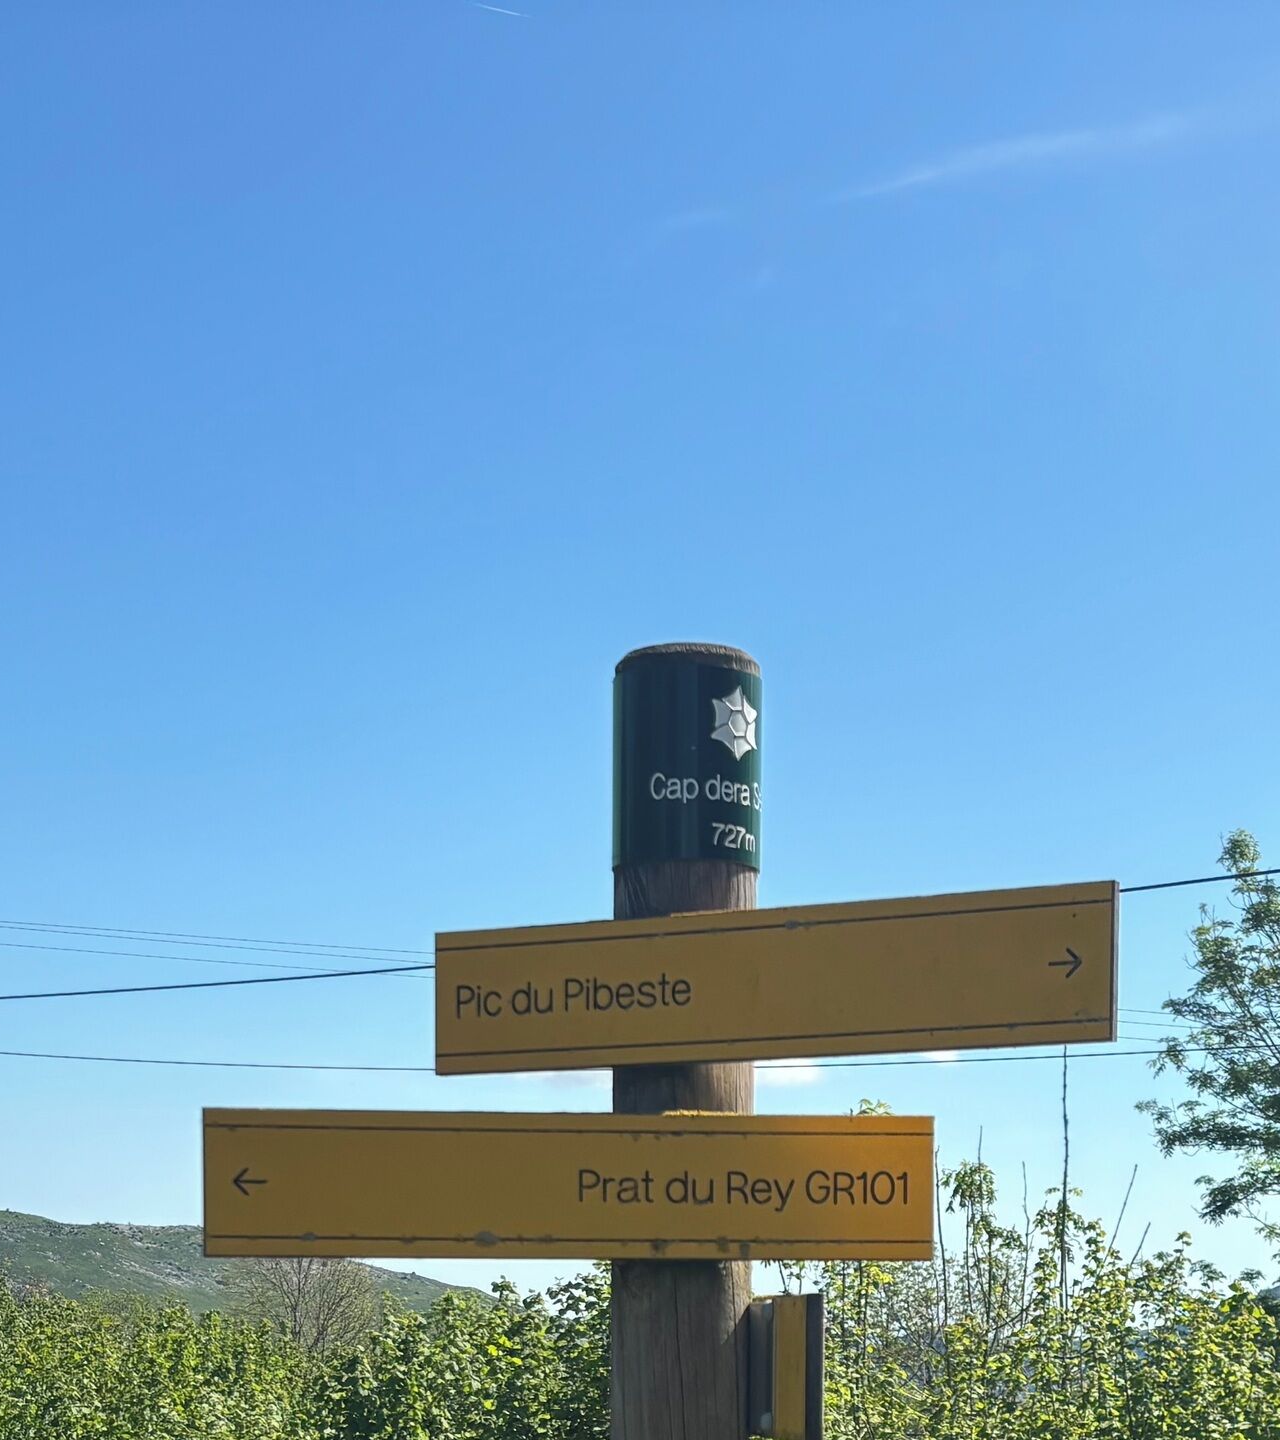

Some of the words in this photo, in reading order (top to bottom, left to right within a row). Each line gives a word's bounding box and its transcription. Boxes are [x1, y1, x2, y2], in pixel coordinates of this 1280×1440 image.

[651, 772, 700, 804] Cap
[705, 774, 751, 806] dera
[712, 822, 756, 853] 727m
[455, 984, 503, 1019] Pic
[511, 981, 554, 1015] du
[564, 972, 692, 1012] Pibeste
[578, 1168, 655, 1205] Prat
[665, 1170, 714, 1205] du
[726, 1171, 795, 1213] Rey
[805, 1170, 909, 1206] GR101
